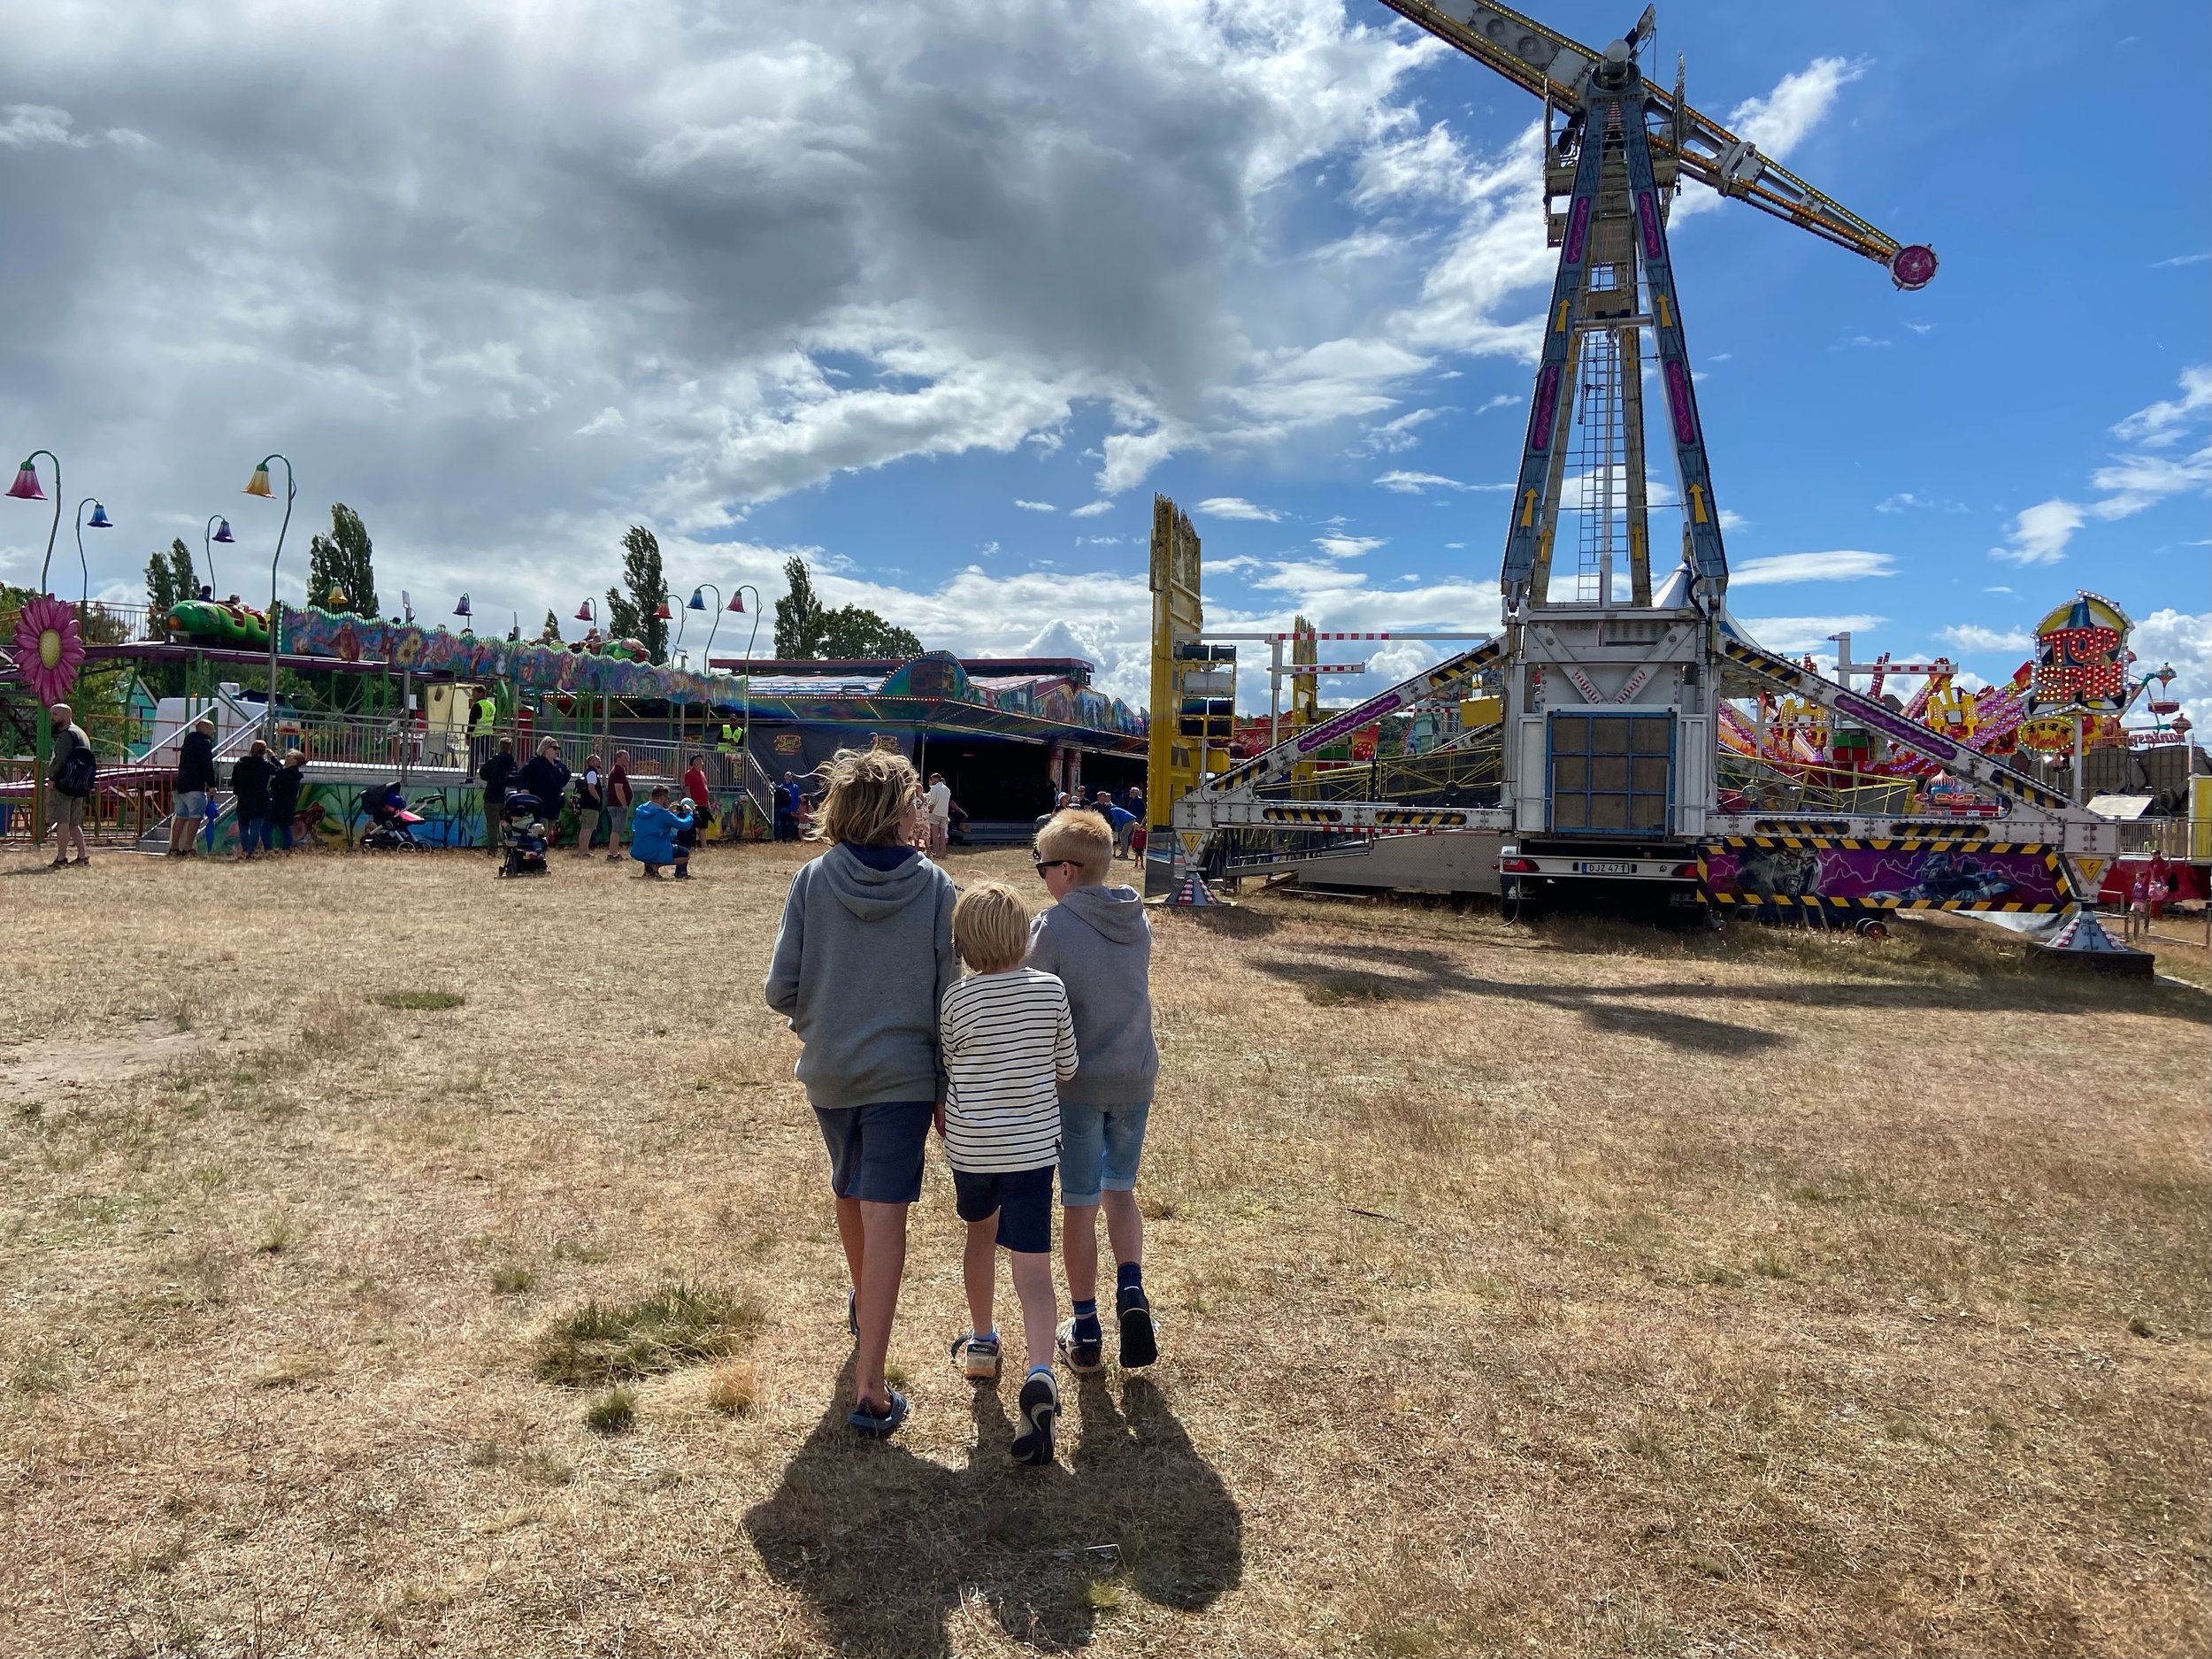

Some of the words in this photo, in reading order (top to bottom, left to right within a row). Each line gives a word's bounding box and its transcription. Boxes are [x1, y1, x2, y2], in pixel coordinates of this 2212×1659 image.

[2042, 626, 2120, 665] TOP
[2035, 661, 2123, 703] SPIN
[1589, 864, 1606, 872] DJZ
